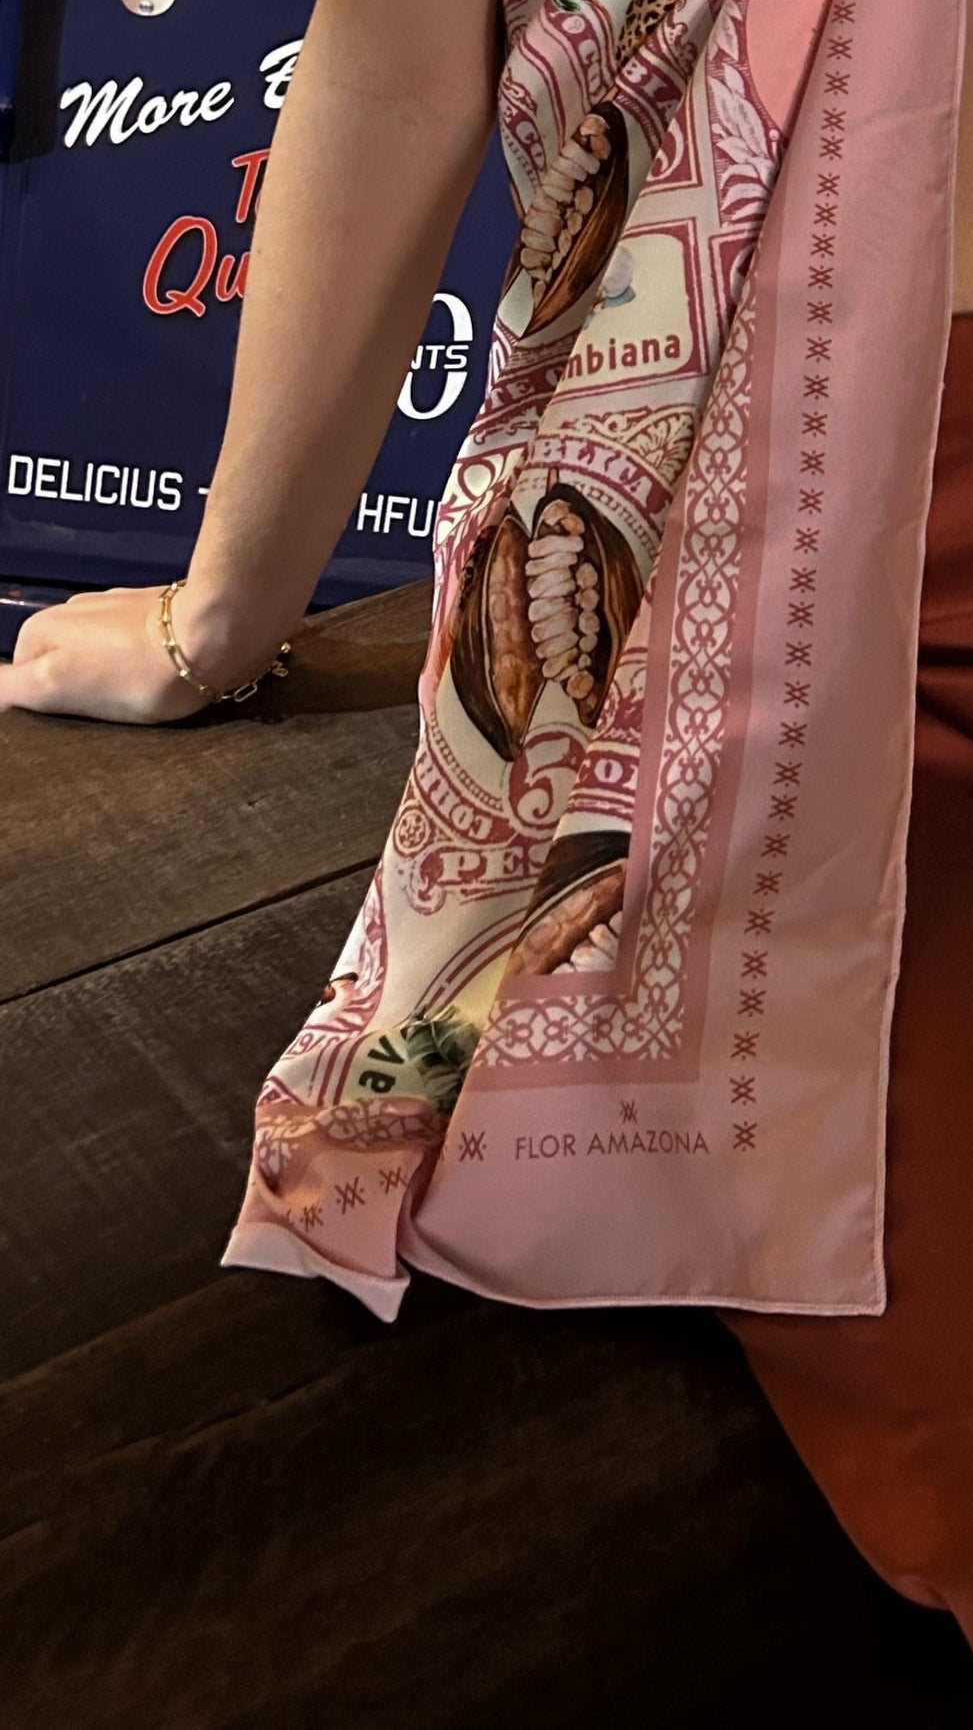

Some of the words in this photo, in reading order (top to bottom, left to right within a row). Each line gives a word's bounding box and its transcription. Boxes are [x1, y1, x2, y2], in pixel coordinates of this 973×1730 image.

[60, 76, 235, 148] More
[8, 454, 183, 511] DELICIUS
[515, 1135, 576, 1161] FLOR
[586, 1129, 710, 1157] AMAZONA
